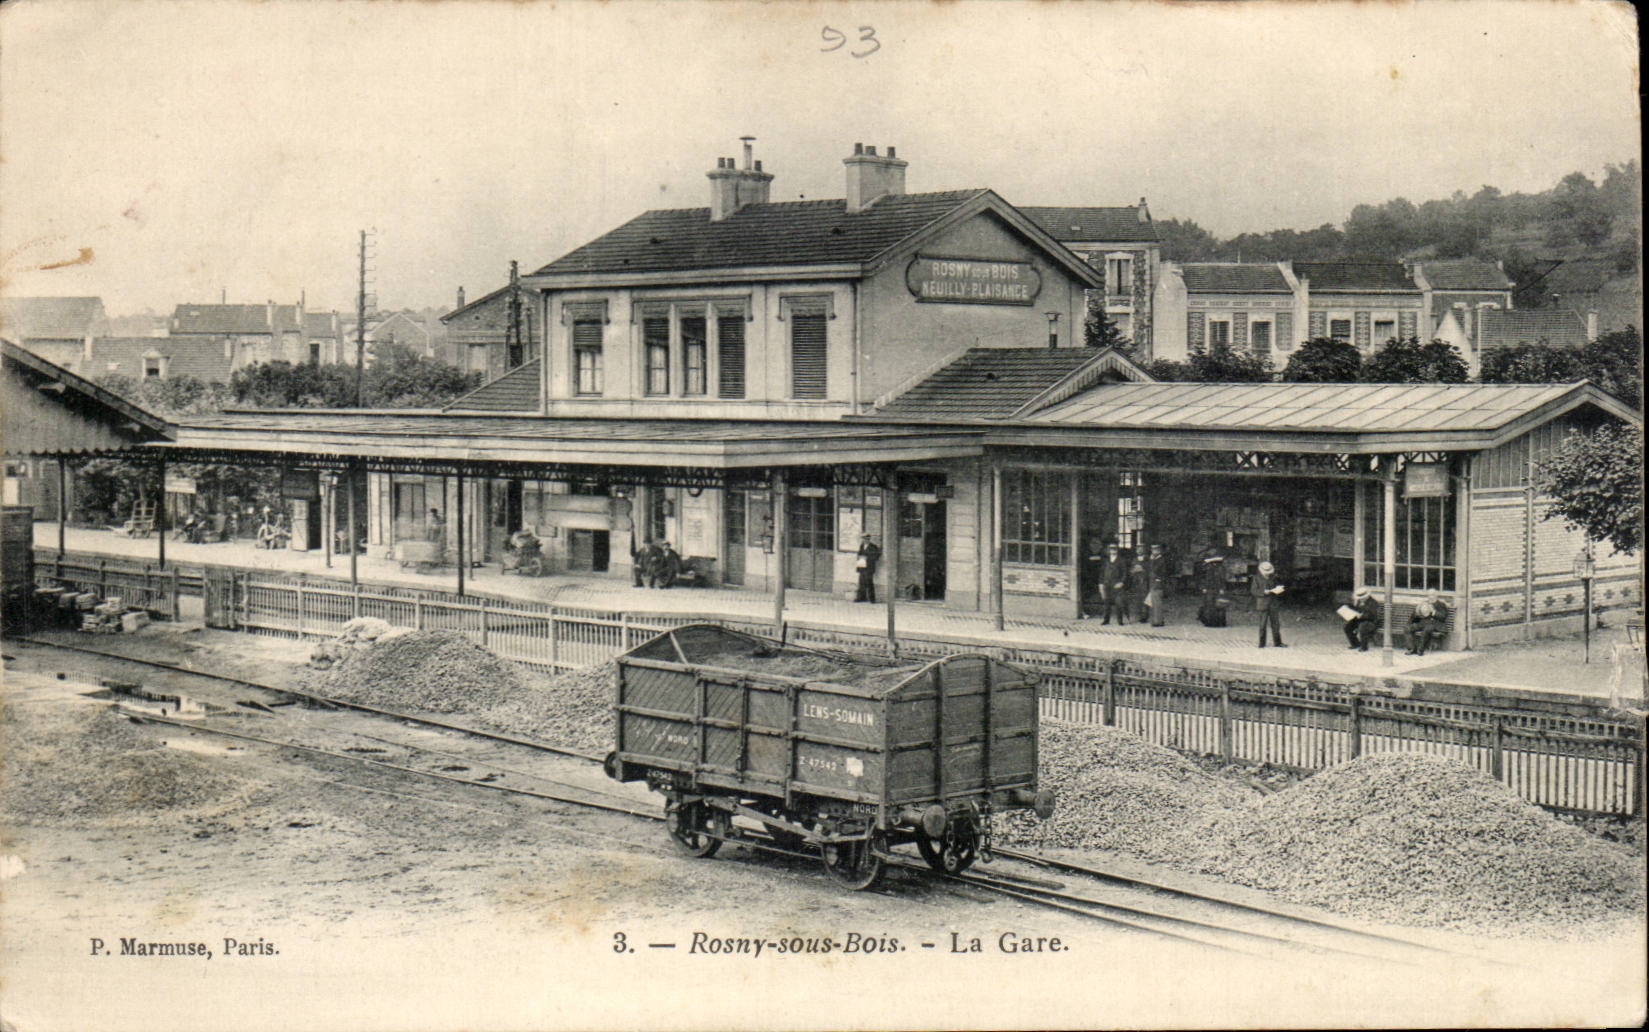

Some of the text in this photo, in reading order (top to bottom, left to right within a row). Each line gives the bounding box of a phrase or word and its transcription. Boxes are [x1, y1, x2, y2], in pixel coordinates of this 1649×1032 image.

[820, 25, 881, 58] 93
[932, 262, 971, 278] ROSNY
[991, 264, 1019, 280] BOIS
[803, 703, 874, 726] LENS-SOMAIN
[853, 803, 878, 815] NORD
